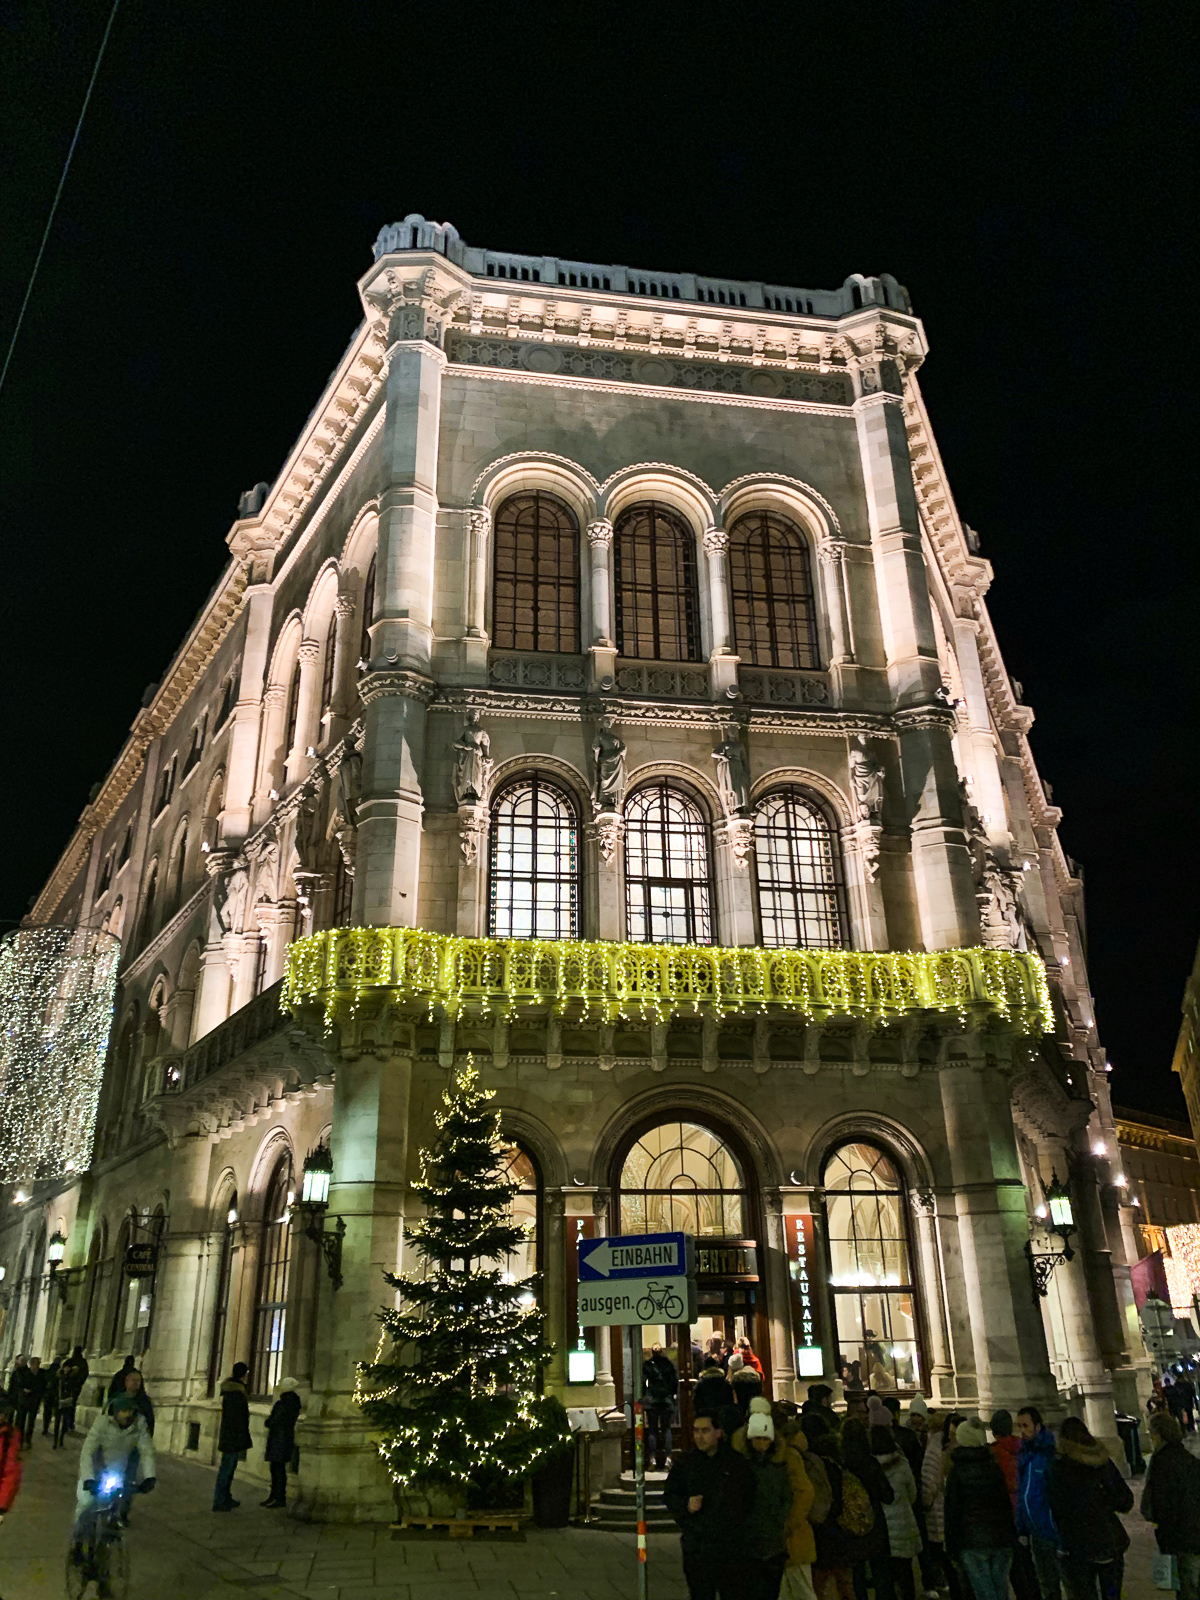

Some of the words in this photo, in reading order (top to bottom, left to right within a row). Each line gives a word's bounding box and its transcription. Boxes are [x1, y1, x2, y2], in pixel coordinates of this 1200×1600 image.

[611, 1245, 673, 1267] EINBAHN
[795, 1219, 813, 1346] RESTAURANT
[581, 1295, 635, 1315] ausgen.
